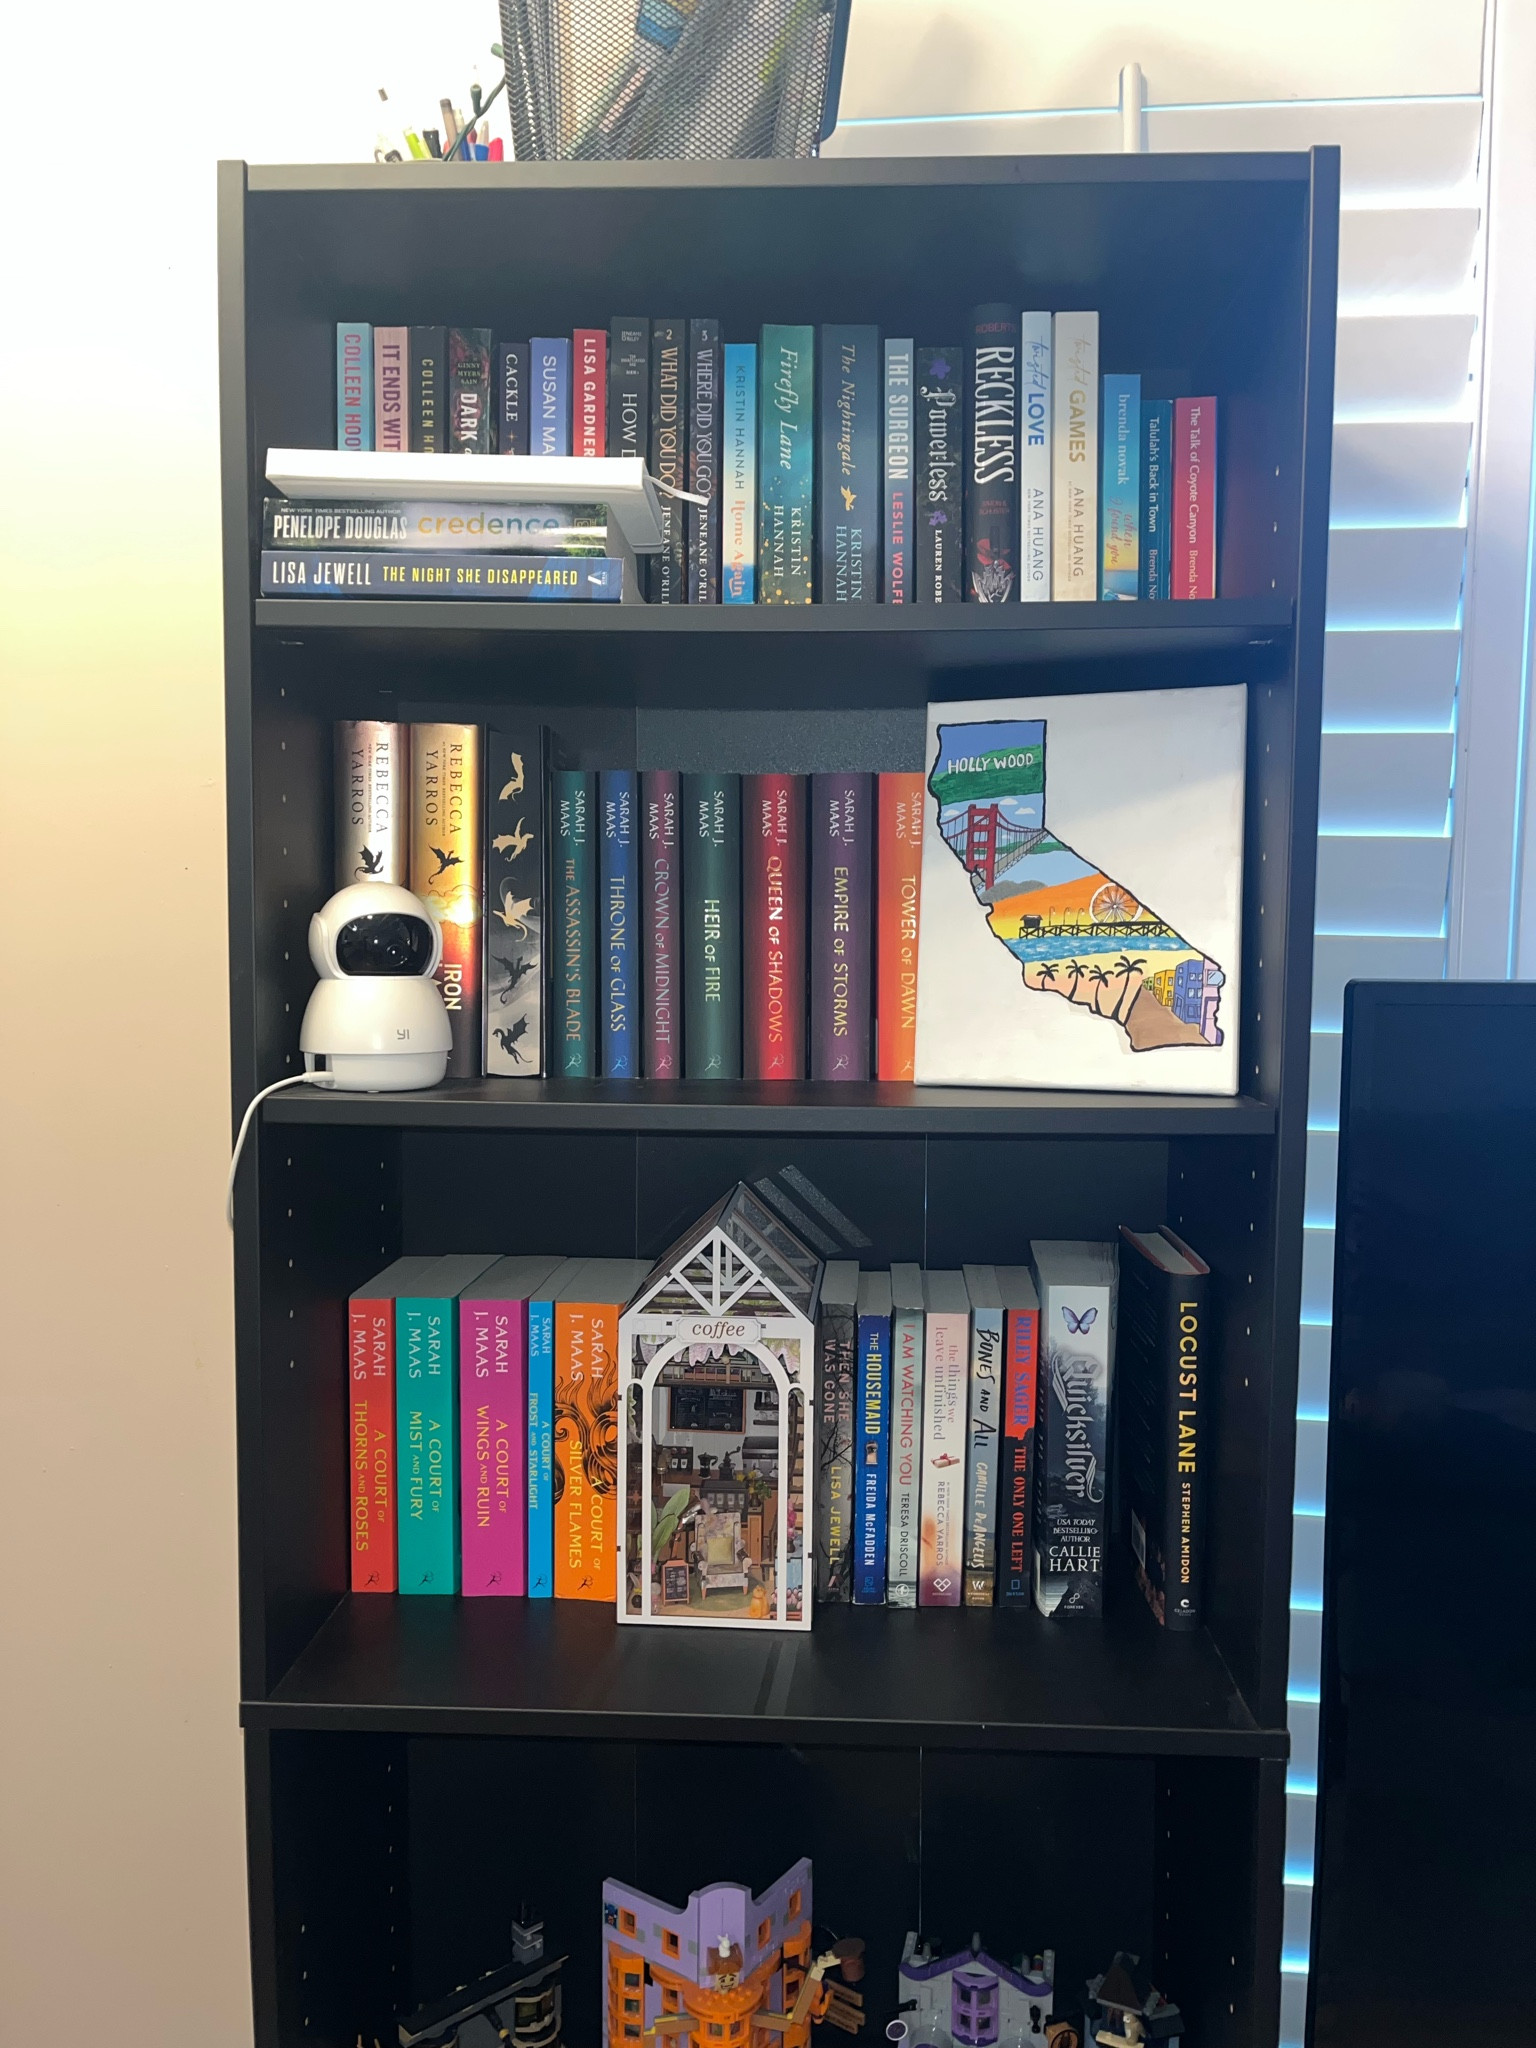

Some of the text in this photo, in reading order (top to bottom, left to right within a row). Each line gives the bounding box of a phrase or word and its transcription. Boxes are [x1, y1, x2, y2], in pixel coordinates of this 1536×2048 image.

[382, 345, 400, 360] IT
[660, 347, 678, 391] WHAT
[666, 329, 673, 340] 2
[344, 334, 362, 451] COLLEEN HOO
[382, 366, 401, 413] ENDS
[460, 393, 478, 441] DARK
[505, 353, 519, 422] CACKLE
[583, 338, 597, 458] LISA GARDNER
[621, 393, 638, 443] HOW
[660, 393, 677, 422] DID
[735, 365, 746, 490] KRISTIN HANNAH
[773, 346, 799, 470] Firefly Lane
[836, 344, 857, 476] The Nightingale
[888, 353, 909, 480] THE SURGEON
[974, 346, 1015, 484] RECKLESS
[1027, 393, 1045, 446] LOVE
[1069, 389, 1086, 463] GAMES
[659, 425, 677, 459] YOU
[920, 385, 957, 502] Powerless
[1117, 394, 1131, 486] brenda novak
[1148, 416, 1160, 533] Talulah's Back in Town
[1186, 406, 1201, 544] The Talk of Coyote Canyon
[273, 514, 408, 540] PENELOPE DOUGLAS
[417, 512, 560, 535] credence
[729, 500, 745, 599] Home Again
[892, 492, 904, 545] LESLIE
[1073, 487, 1085, 577] ANA HUANG
[1106, 543, 1120, 565] you
[1123, 513, 1138, 547] when
[272, 561, 372, 586] LISA JEWELL
[382, 565, 578, 586] THE NIGHT SHE DISAPPEARED
[351, 748, 364, 826] YARROS
[375, 742, 390, 833] REBECCA
[560, 800, 571, 837] MAAS
[573, 790, 586, 846] SARAH J.
[443, 963, 463, 1011] IRON
[565, 858, 582, 1042] THE ASSASSIN'S BLADE
[610, 875, 626, 1032] THRONE OF GLASS
[704, 899, 721, 1003] HEIR OF FIRE
[766, 855, 784, 1043] QUEEN OF SHADOWS
[900, 874, 917, 1029] TOWER OF DAWN
[351, 1313, 367, 1380] J. MAAS
[373, 1316, 386, 1377] SARAH
[691, 1321, 746, 1340] coffee
[902, 1332, 915, 1359] AM
[976, 1328, 1000, 1385] BONES
[1013, 1316, 1032, 1426] RILEY SAGER
[823, 1339, 837, 1423] WAS GONE
[838, 1341, 851, 1422] THEN SHE
[865, 1332, 882, 1435] THE HOUSEMAID
[900, 1364, 915, 1449] WATCHING
[933, 1327, 948, 1441] leave unfinished
[946, 1344, 961, 1424] the things we
[979, 1388, 991, 1413] AND
[1177, 1302, 1198, 1473] LOCUST LANE
[409, 1410, 424, 1522] MIST AND FURY
[476, 1404, 490, 1528] WINGS AND RUIN
[1052, 1351, 1104, 1503] Quicksilver
[354, 1400, 369, 1552] THORNS AND ROSES
[373, 1430, 388, 1524] A COURT OF
[569, 1439, 583, 1570] SILVER FLAMES
[899, 1453, 913, 1486] YOU
[975, 1462, 989, 1508] CAMILLE
[1010, 1446, 1027, 1573] THE ONLY ONE LEFT
[590, 1476, 604, 1570] A COURT OF
[864, 1473, 877, 1566] FREIDA McFADDEN
[899, 1493, 910, 1577] TERESA DRISCOLL
[1049, 1545, 1101, 1558] CALLIE
[1053, 1527, 1099, 1535] BESTSELLING
[1056, 1518, 1096, 1526] USA TODAY
[1060, 1535, 1091, 1543] AUTHOR
[1180, 1482, 1191, 1584] STEPHEN AMIDON
[1049, 1558, 1100, 1573] HART
